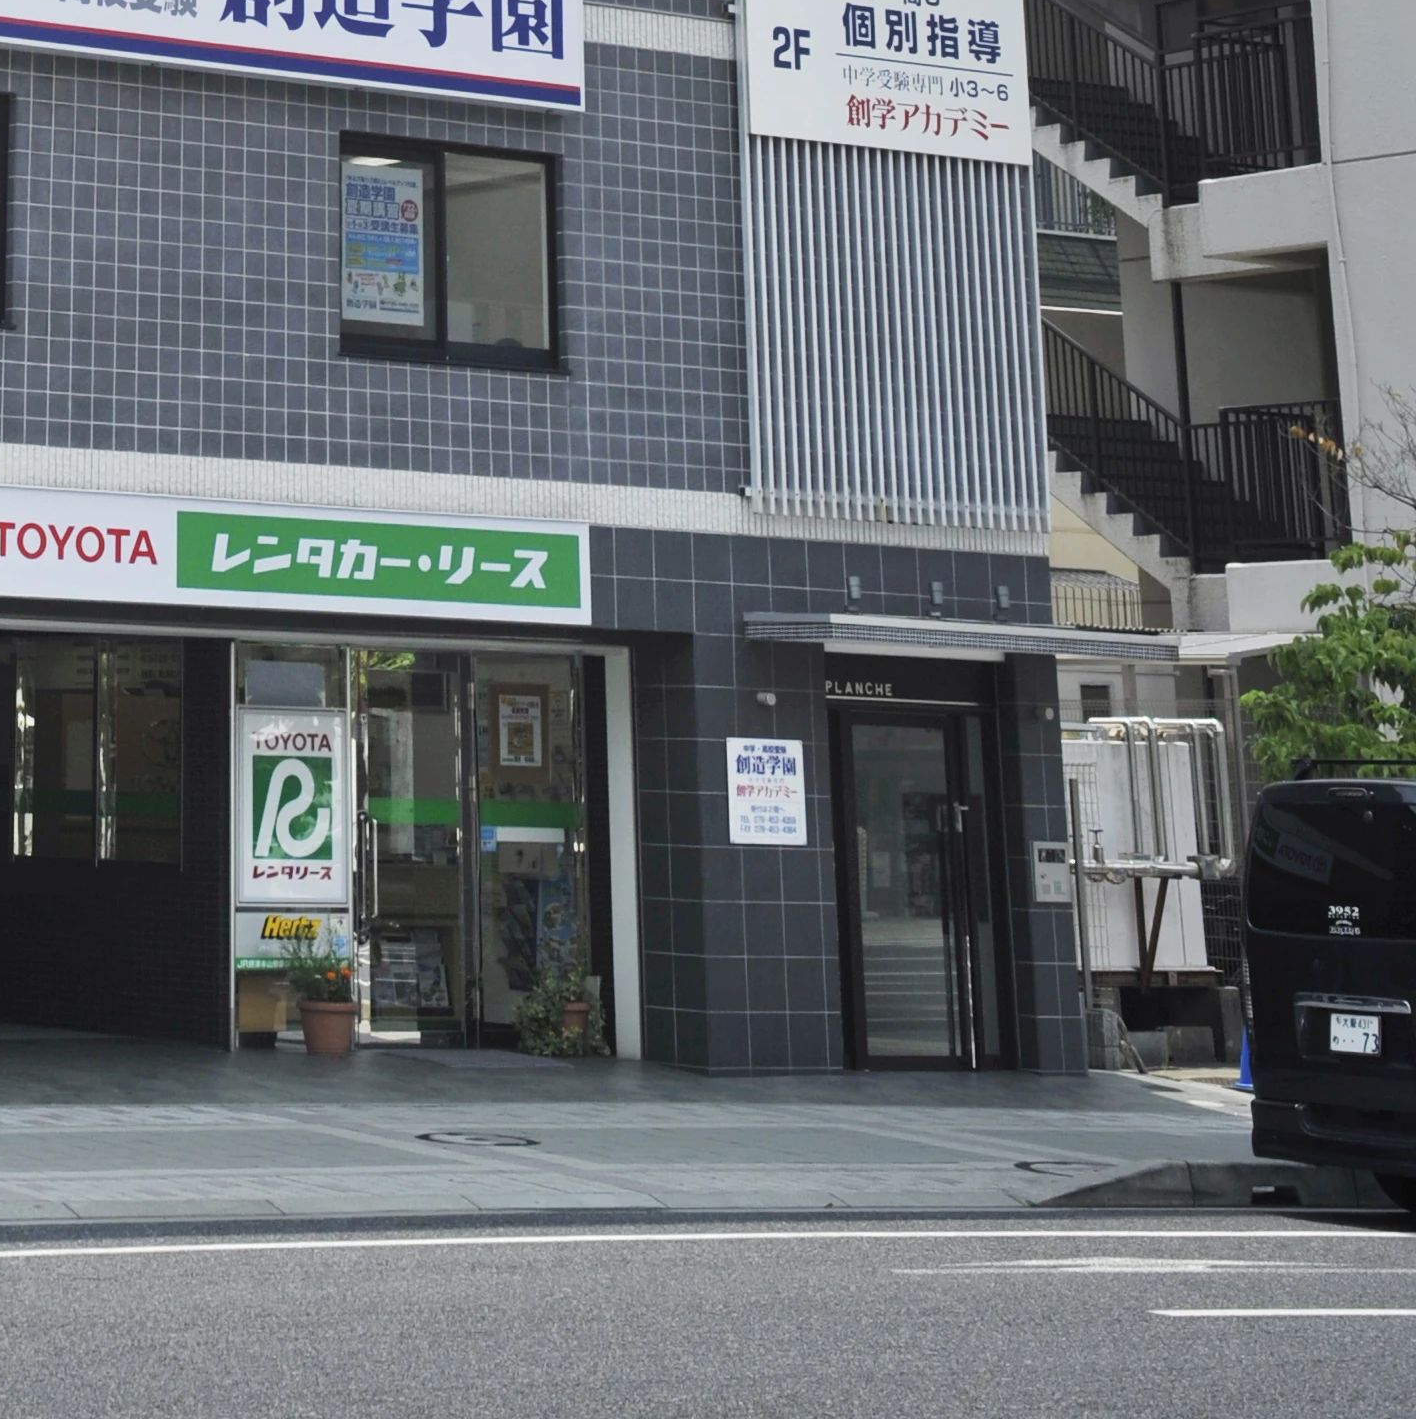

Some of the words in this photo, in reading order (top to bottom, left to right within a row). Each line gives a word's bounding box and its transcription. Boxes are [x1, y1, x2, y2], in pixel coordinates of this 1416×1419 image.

[772, 26, 811, 70] 2F
[841, 2, 1002, 65] 個別指導
[842, 64, 944, 97] 中学受験専門
[845, 93, 1010, 142] 創学アカデミー
[210, 532, 550, 590] レンタカー・リース
[825, 680, 893, 696] PLANCHE
[736, 754, 797, 776] 創造学園
[252, 865, 333, 880] レンタリース
[261, 914, 323, 941] Hertz
